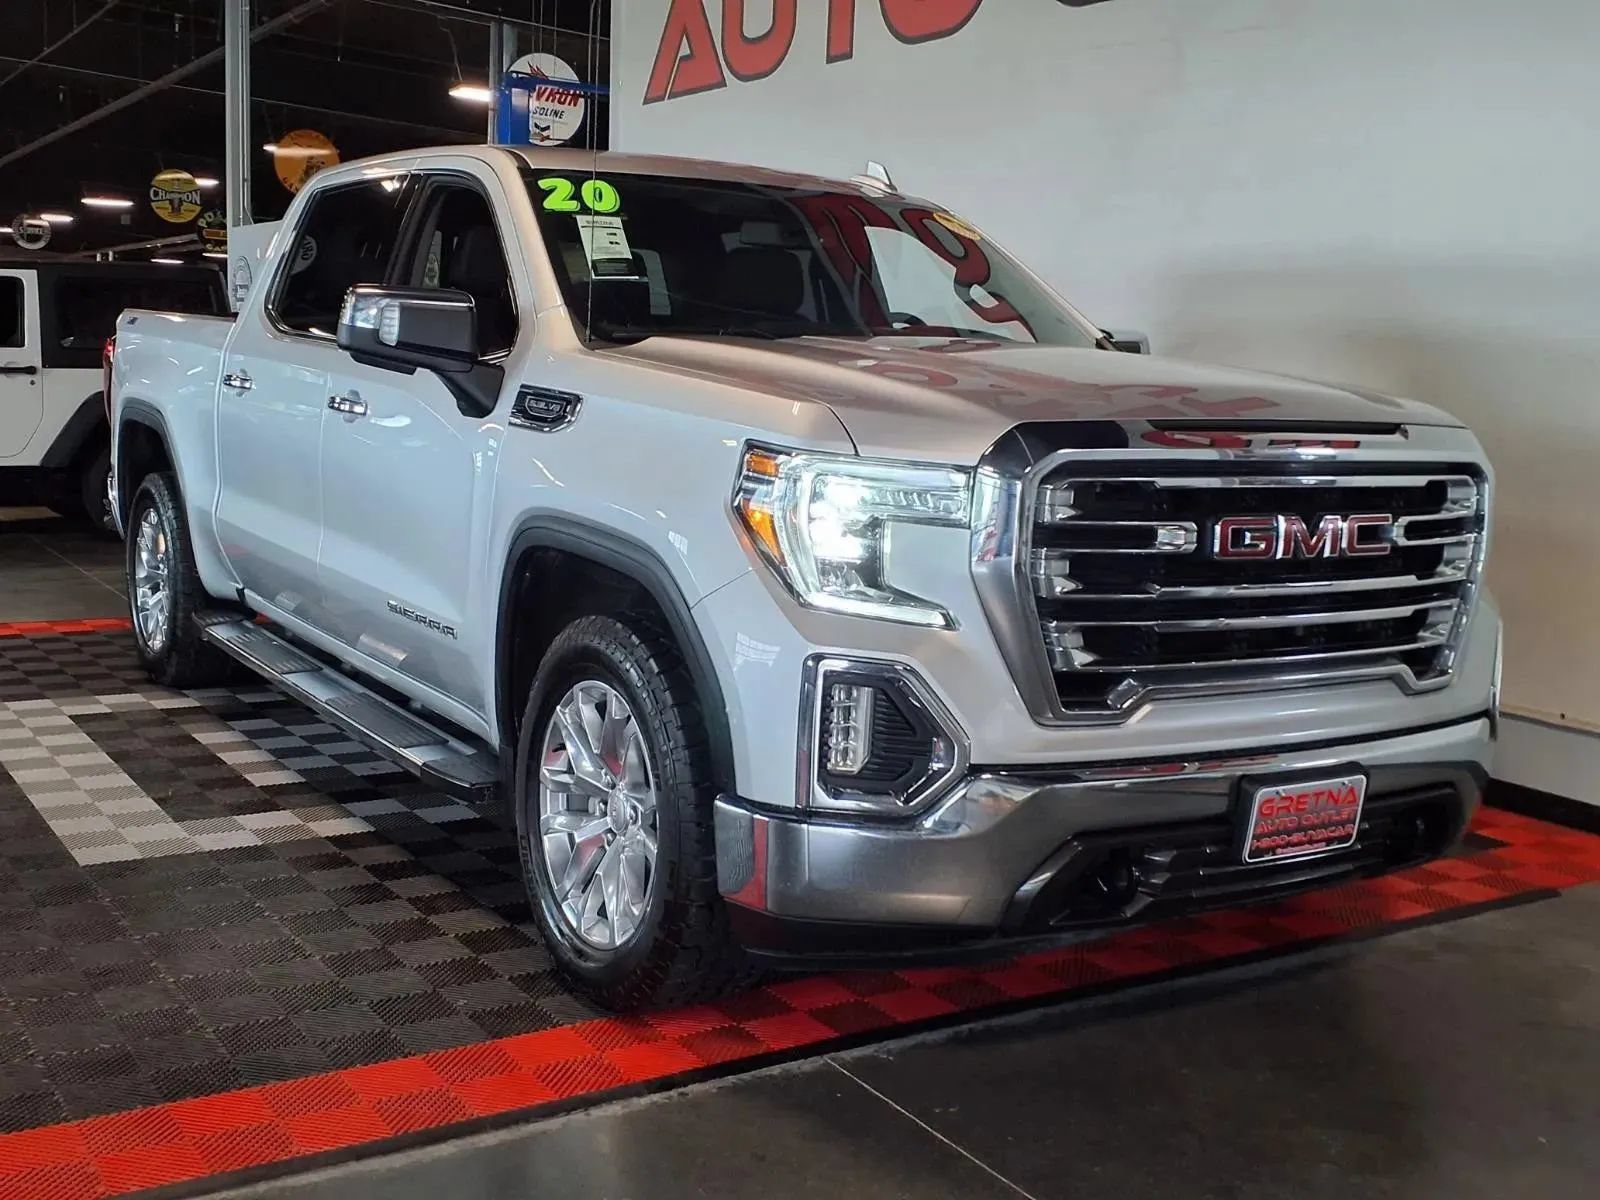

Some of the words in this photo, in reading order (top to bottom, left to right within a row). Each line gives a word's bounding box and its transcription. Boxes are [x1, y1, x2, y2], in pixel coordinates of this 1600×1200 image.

[532, 105, 566, 119] SOLINE
[537, 177, 620, 213] 20
[1213, 513, 1393, 560] GMC
[386, 600, 458, 640] SIERRA
[1260, 787, 1357, 816] GRETNA
[1255, 816, 1298, 834] AUTO
